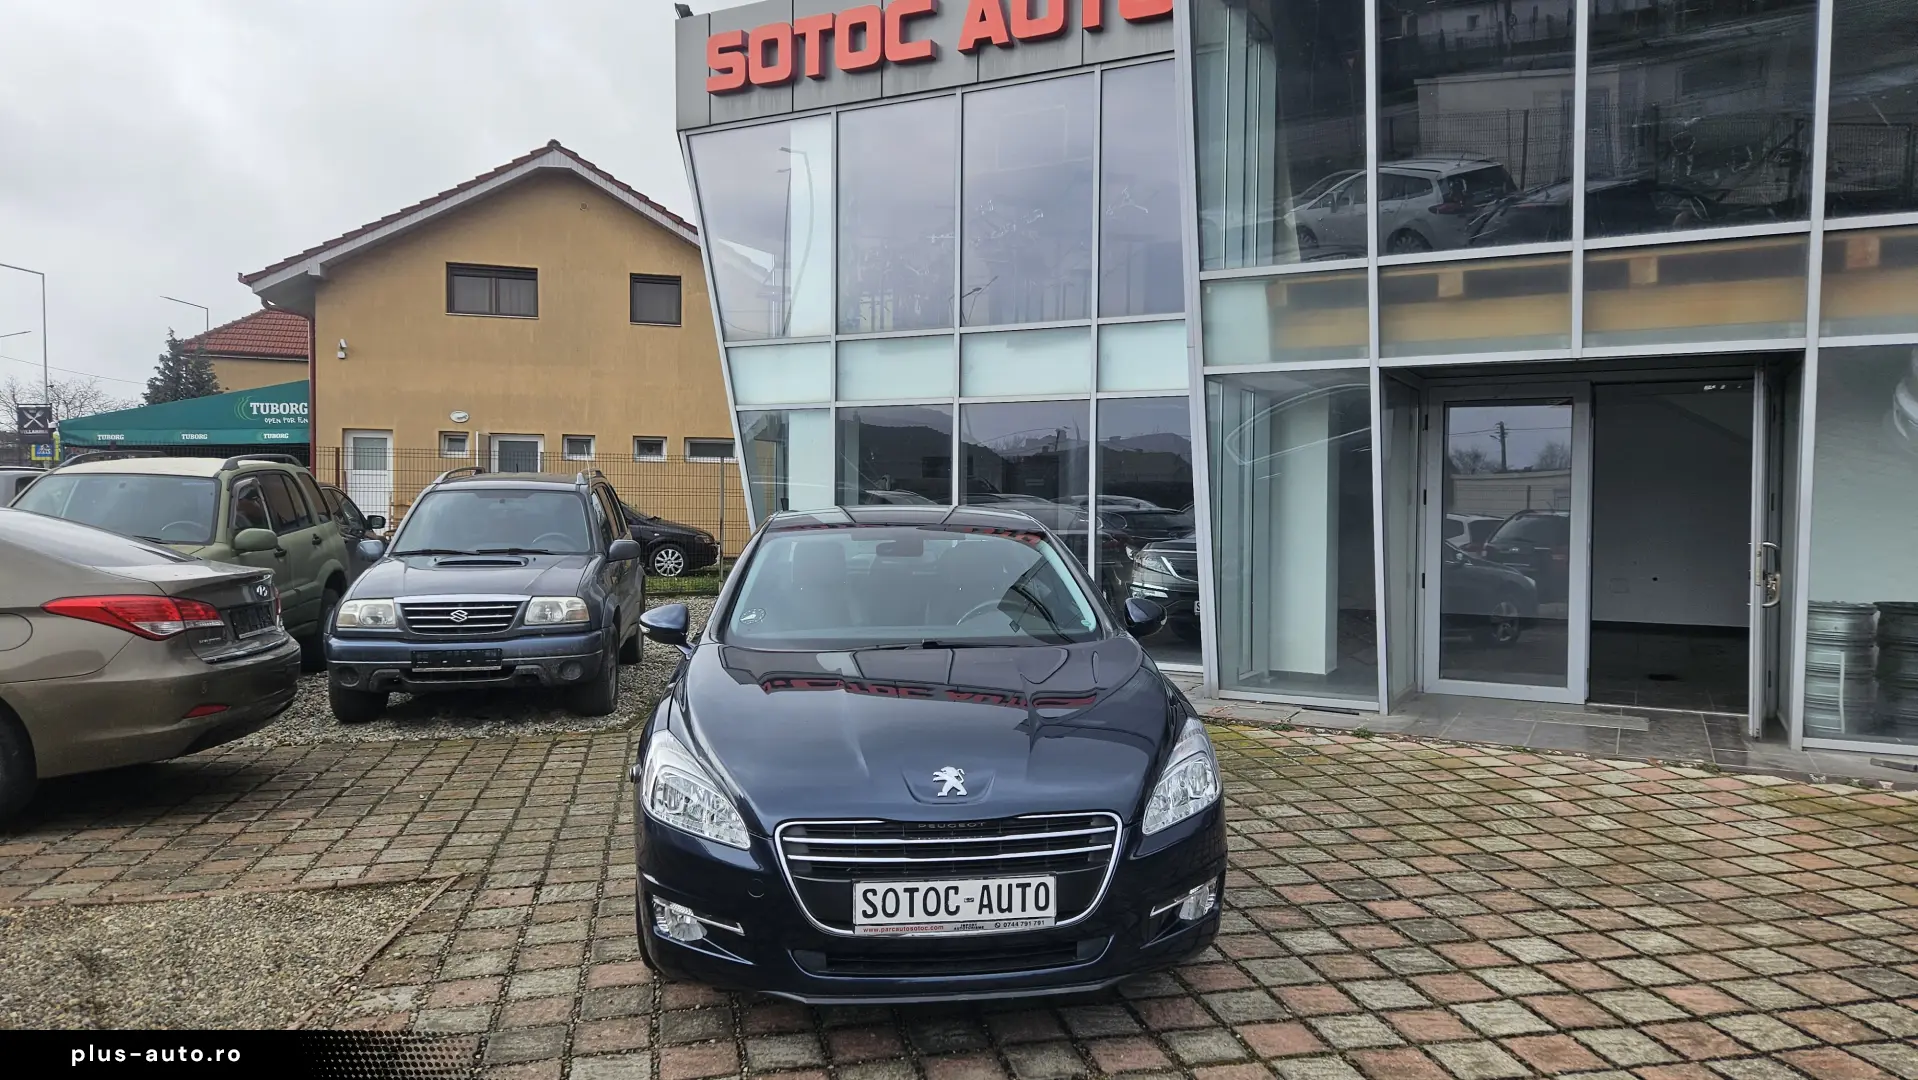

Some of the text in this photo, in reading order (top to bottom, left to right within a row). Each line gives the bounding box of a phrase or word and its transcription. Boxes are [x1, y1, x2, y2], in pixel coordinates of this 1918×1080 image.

[706, 0, 937, 95] SOTOC
[249, 402, 309, 415] TUBORG
[863, 924, 944, 933] www.parcautosotoc.com
